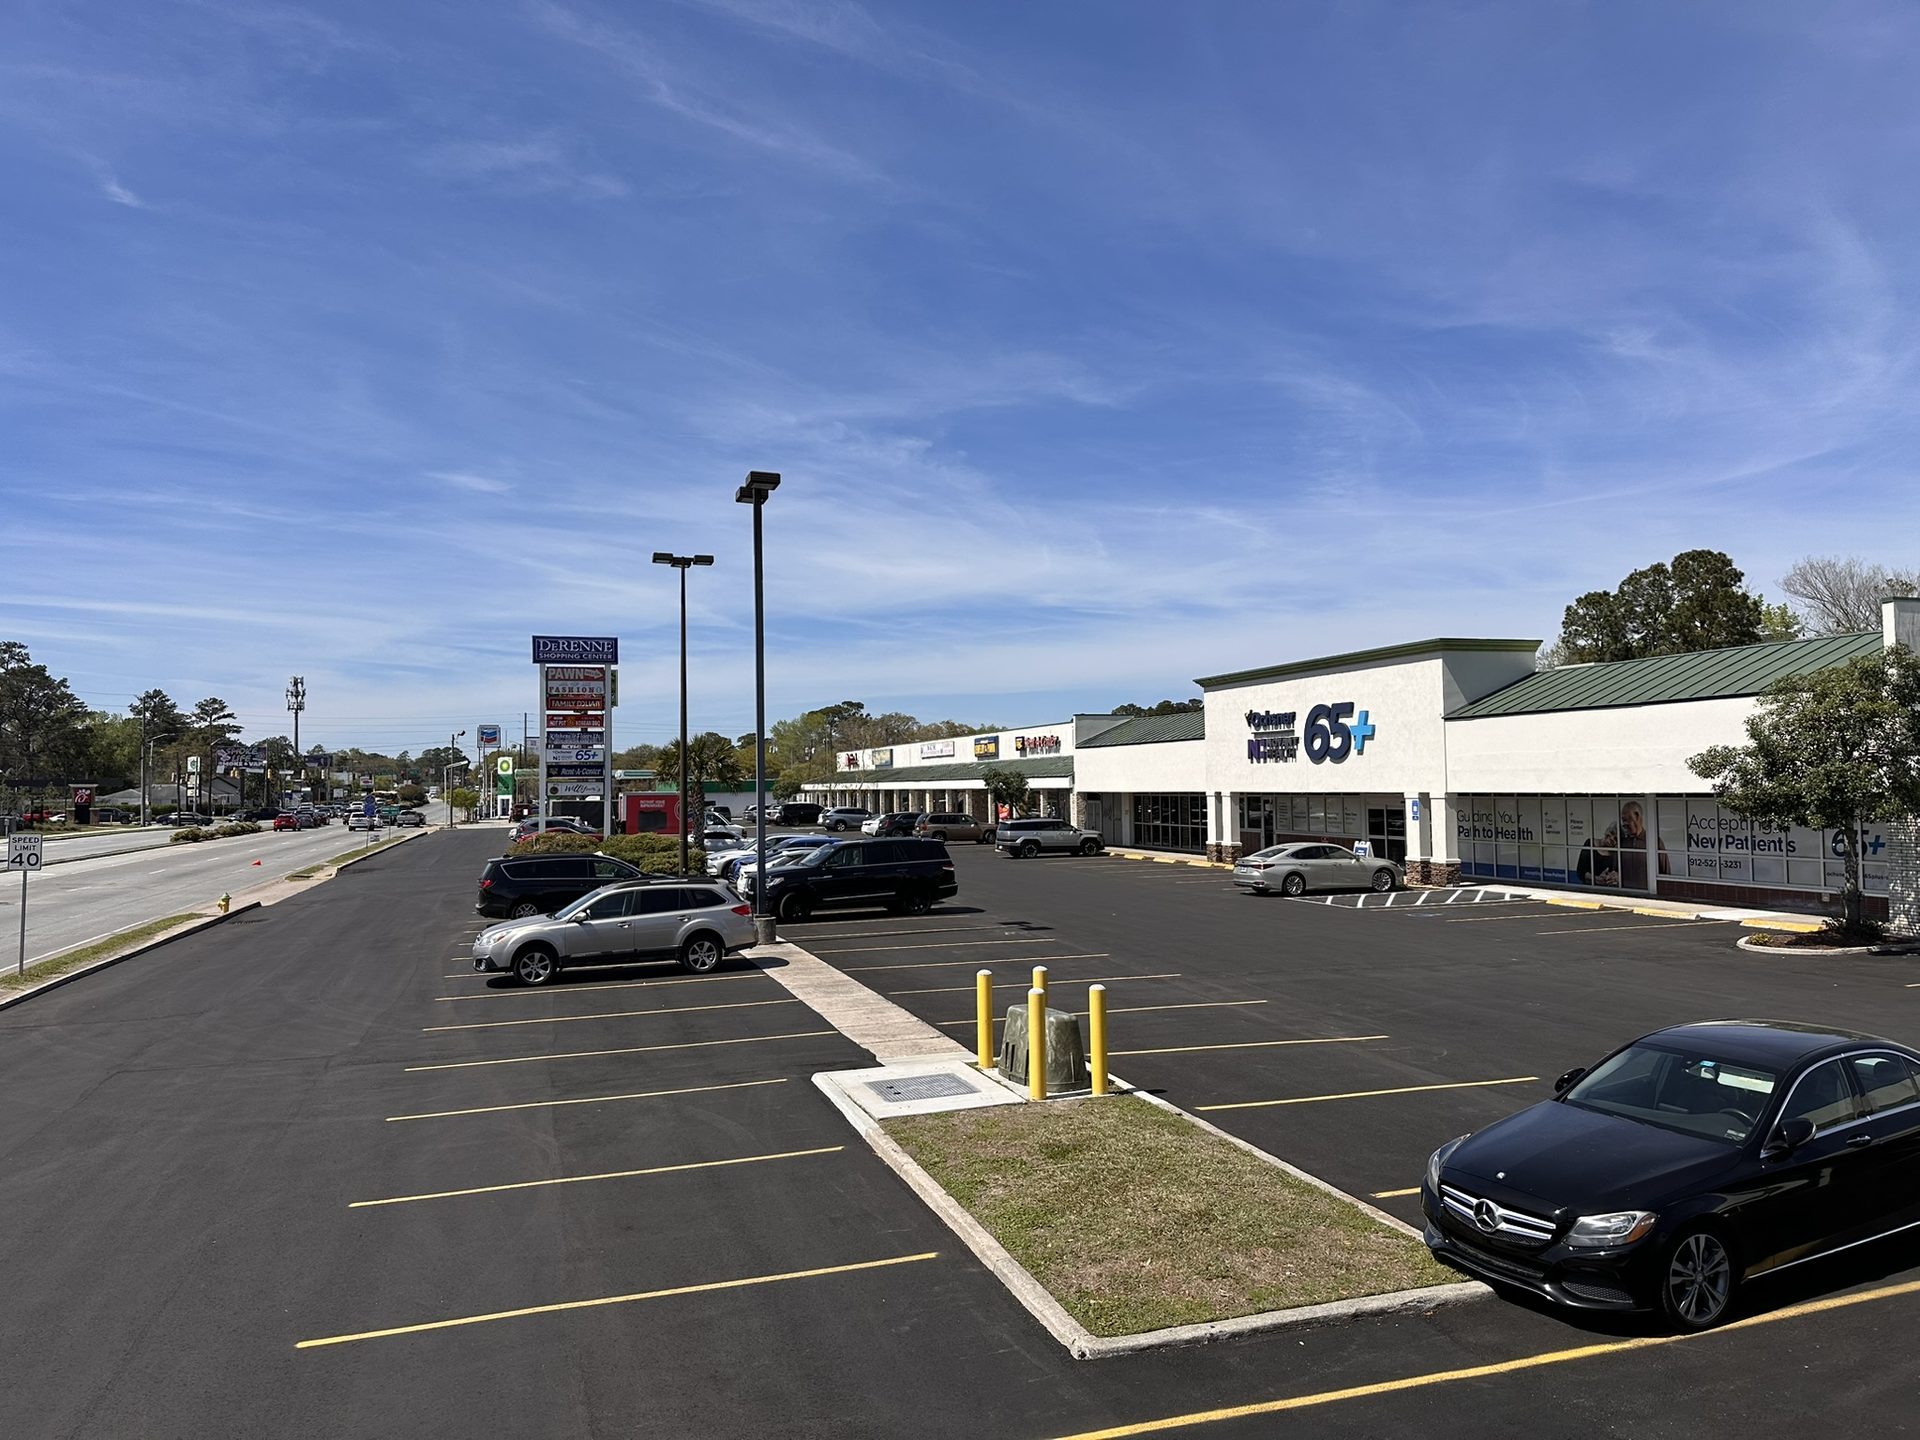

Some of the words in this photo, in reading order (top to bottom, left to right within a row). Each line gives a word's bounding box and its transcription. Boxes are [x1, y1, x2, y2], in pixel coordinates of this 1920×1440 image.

[548, 668, 585, 680] PAWN
[1304, 701, 1376, 764] 65+
[575, 750, 599, 761] 65+
[1457, 809, 1494, 826] Guding
[1497, 810, 1524, 824] Your
[1482, 827, 1494, 839] to
[1495, 826, 1534, 841] Health
[1725, 834, 1796, 853] Patients
[10, 852, 40, 867] 40
[1690, 858, 1742, 869] 912-527-3231
